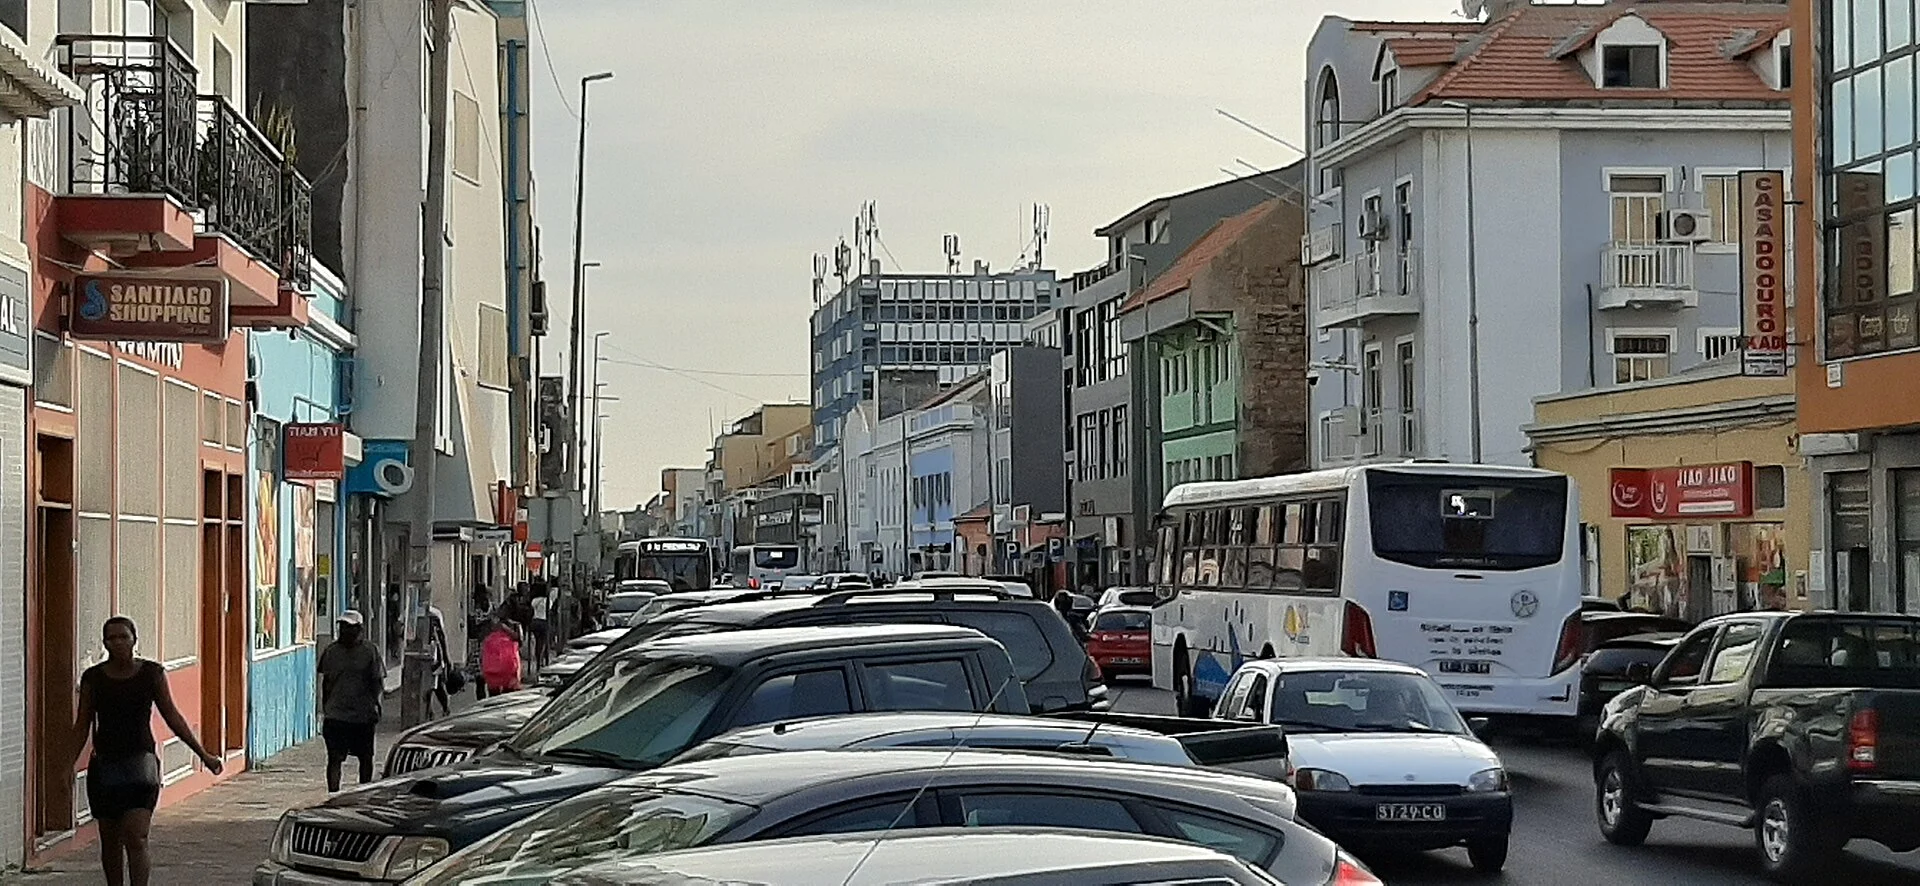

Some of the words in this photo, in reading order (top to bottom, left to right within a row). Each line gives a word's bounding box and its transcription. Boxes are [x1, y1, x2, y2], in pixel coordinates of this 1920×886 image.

[1754, 177, 1775, 237] CASA
[109, 284, 212, 306] SANTIAGO
[109, 303, 212, 325] SHOPPING
[1676, 469, 1703, 488] JIAO
[1708, 465, 1736, 484] JIAO
[1006, 542, 1018, 559] P
[1048, 538, 1061, 556] P
